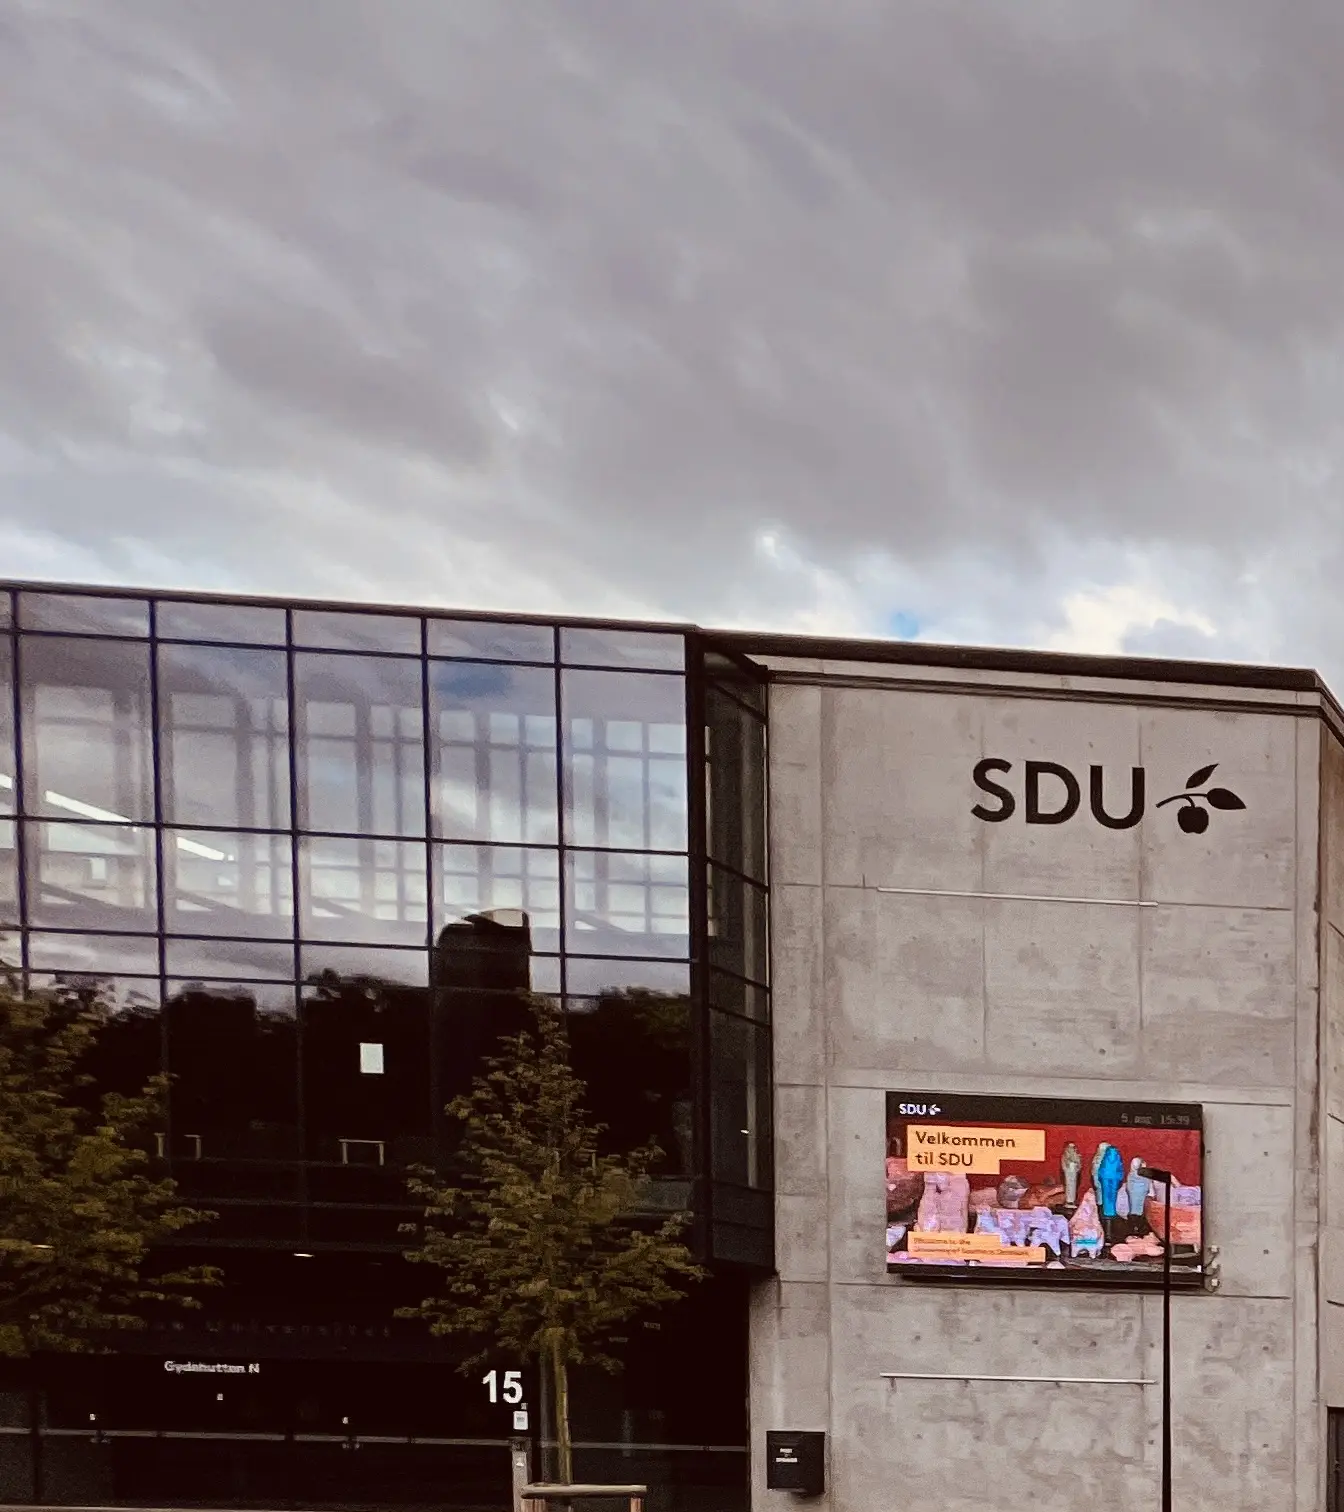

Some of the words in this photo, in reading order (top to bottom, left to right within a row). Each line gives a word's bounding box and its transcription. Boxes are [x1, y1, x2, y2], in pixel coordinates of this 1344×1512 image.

[971, 757, 1145, 830] SDU
[898, 1103, 927, 1115] SDU
[915, 1131, 1016, 1148] Velkommen
[915, 1152, 933, 1165] til
[938, 1153, 973, 1166] SDU
[481, 1370, 523, 1404] 15
